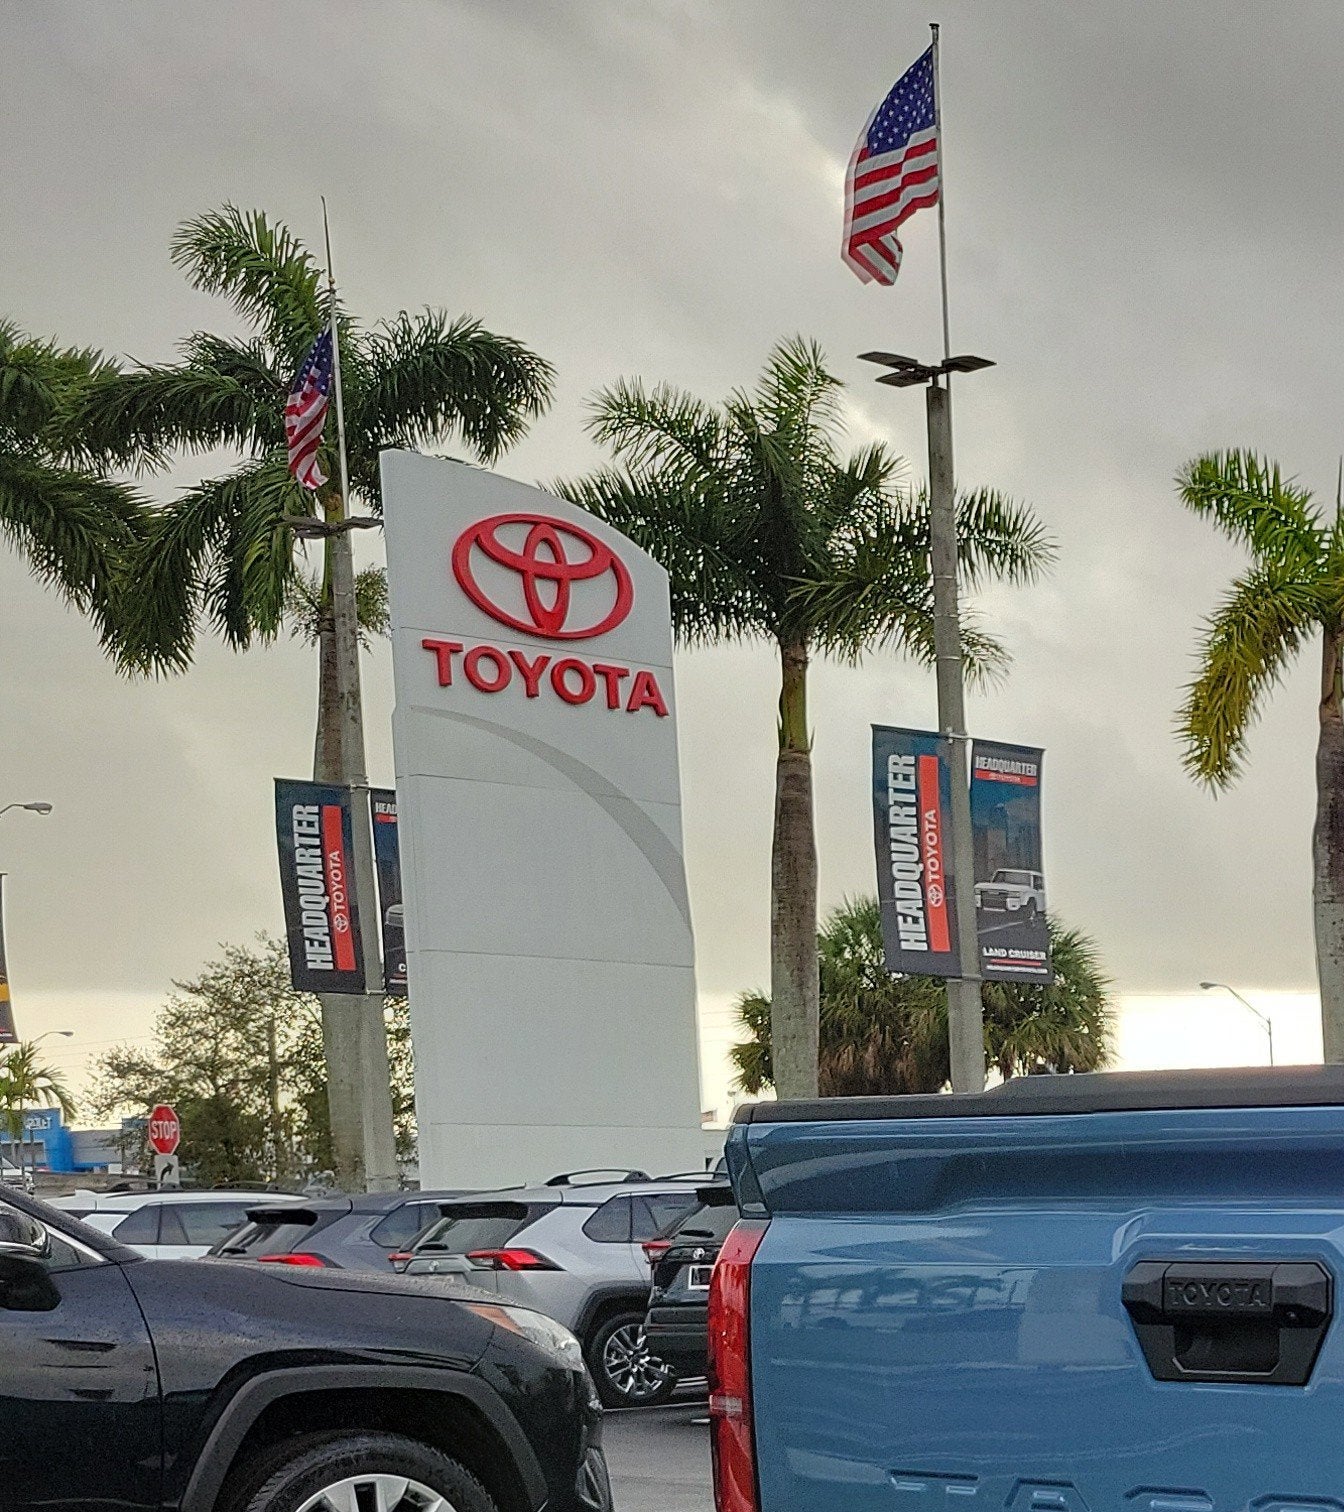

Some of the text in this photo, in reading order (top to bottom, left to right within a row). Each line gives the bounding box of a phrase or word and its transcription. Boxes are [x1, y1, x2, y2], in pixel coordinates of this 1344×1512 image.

[421, 638, 669, 717] TOYOTA
[974, 756, 1038, 777] HEADQUARTER
[887, 754, 928, 951] HEADQUARTER
[925, 809, 942, 883] TOYOTA
[292, 803, 335, 971] HEADQUARTER
[329, 850, 347, 912] TOYOTA
[982, 946, 1047, 961] LAND CRUISER
[150, 1121, 178, 1140] STOP
[1168, 1281, 1267, 1307] TOYOTA
